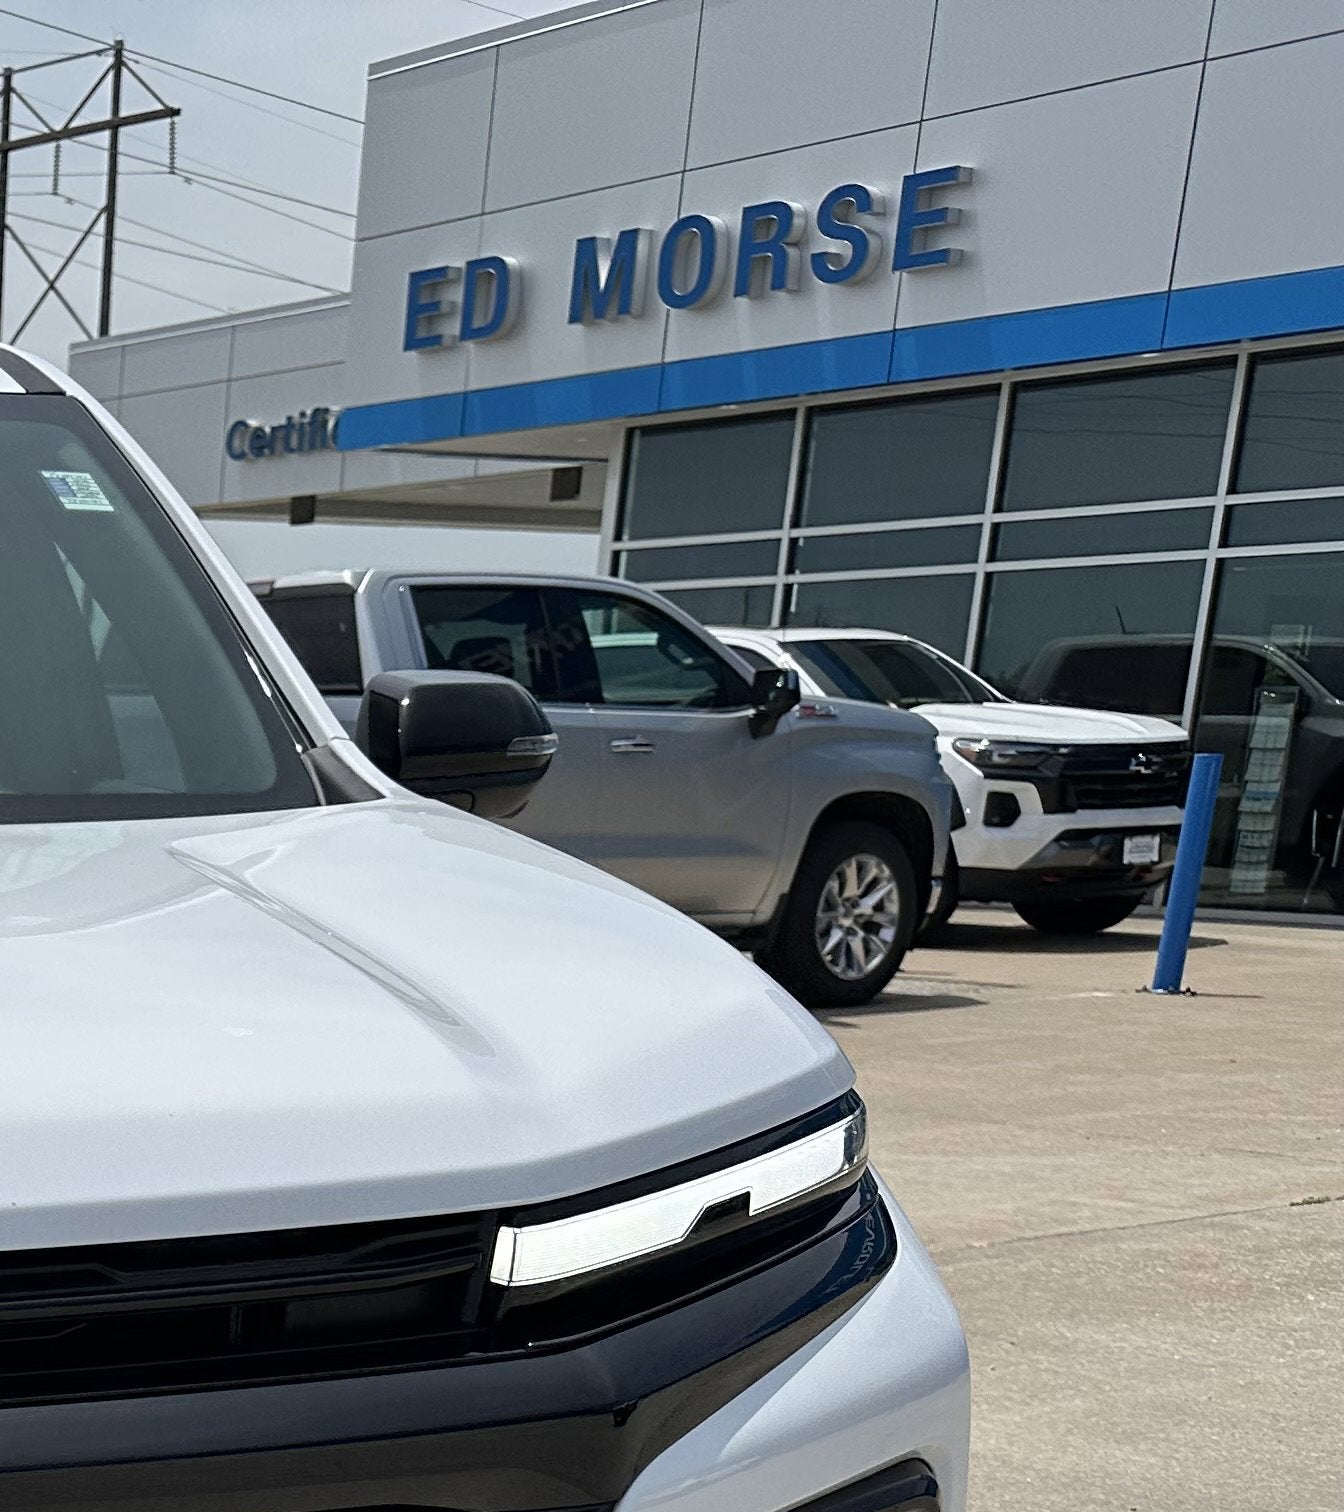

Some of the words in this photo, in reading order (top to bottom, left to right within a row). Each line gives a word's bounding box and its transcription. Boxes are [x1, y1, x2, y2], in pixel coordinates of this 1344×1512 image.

[403, 253, 519, 353] ED
[567, 164, 975, 326] MORSE
[226, 406, 339, 461] Certifi
